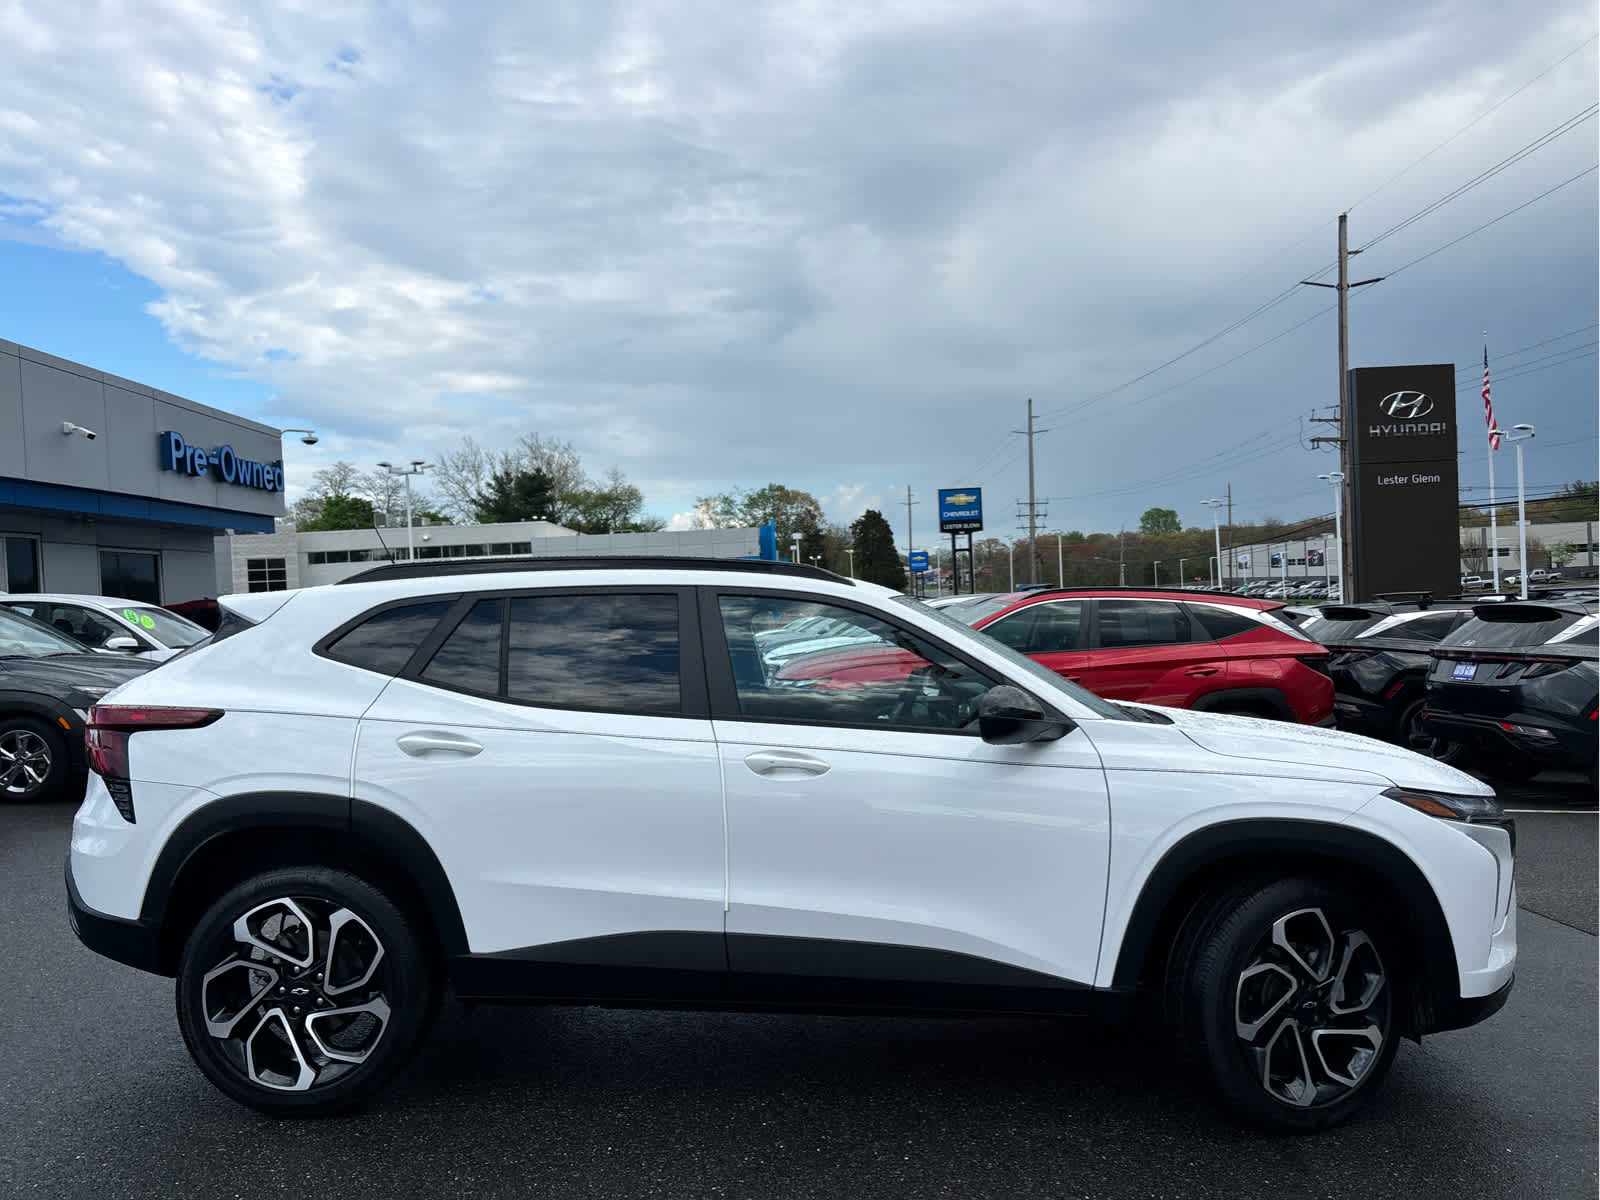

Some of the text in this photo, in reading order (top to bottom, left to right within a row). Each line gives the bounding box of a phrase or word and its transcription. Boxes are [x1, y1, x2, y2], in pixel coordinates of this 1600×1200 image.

[1368, 422, 1446, 437] HYUNDAI
[164, 431, 284, 491] Pre-Owned
[1377, 473, 1441, 485] Lester Glenn
[943, 510, 979, 518] CHEVROLET
